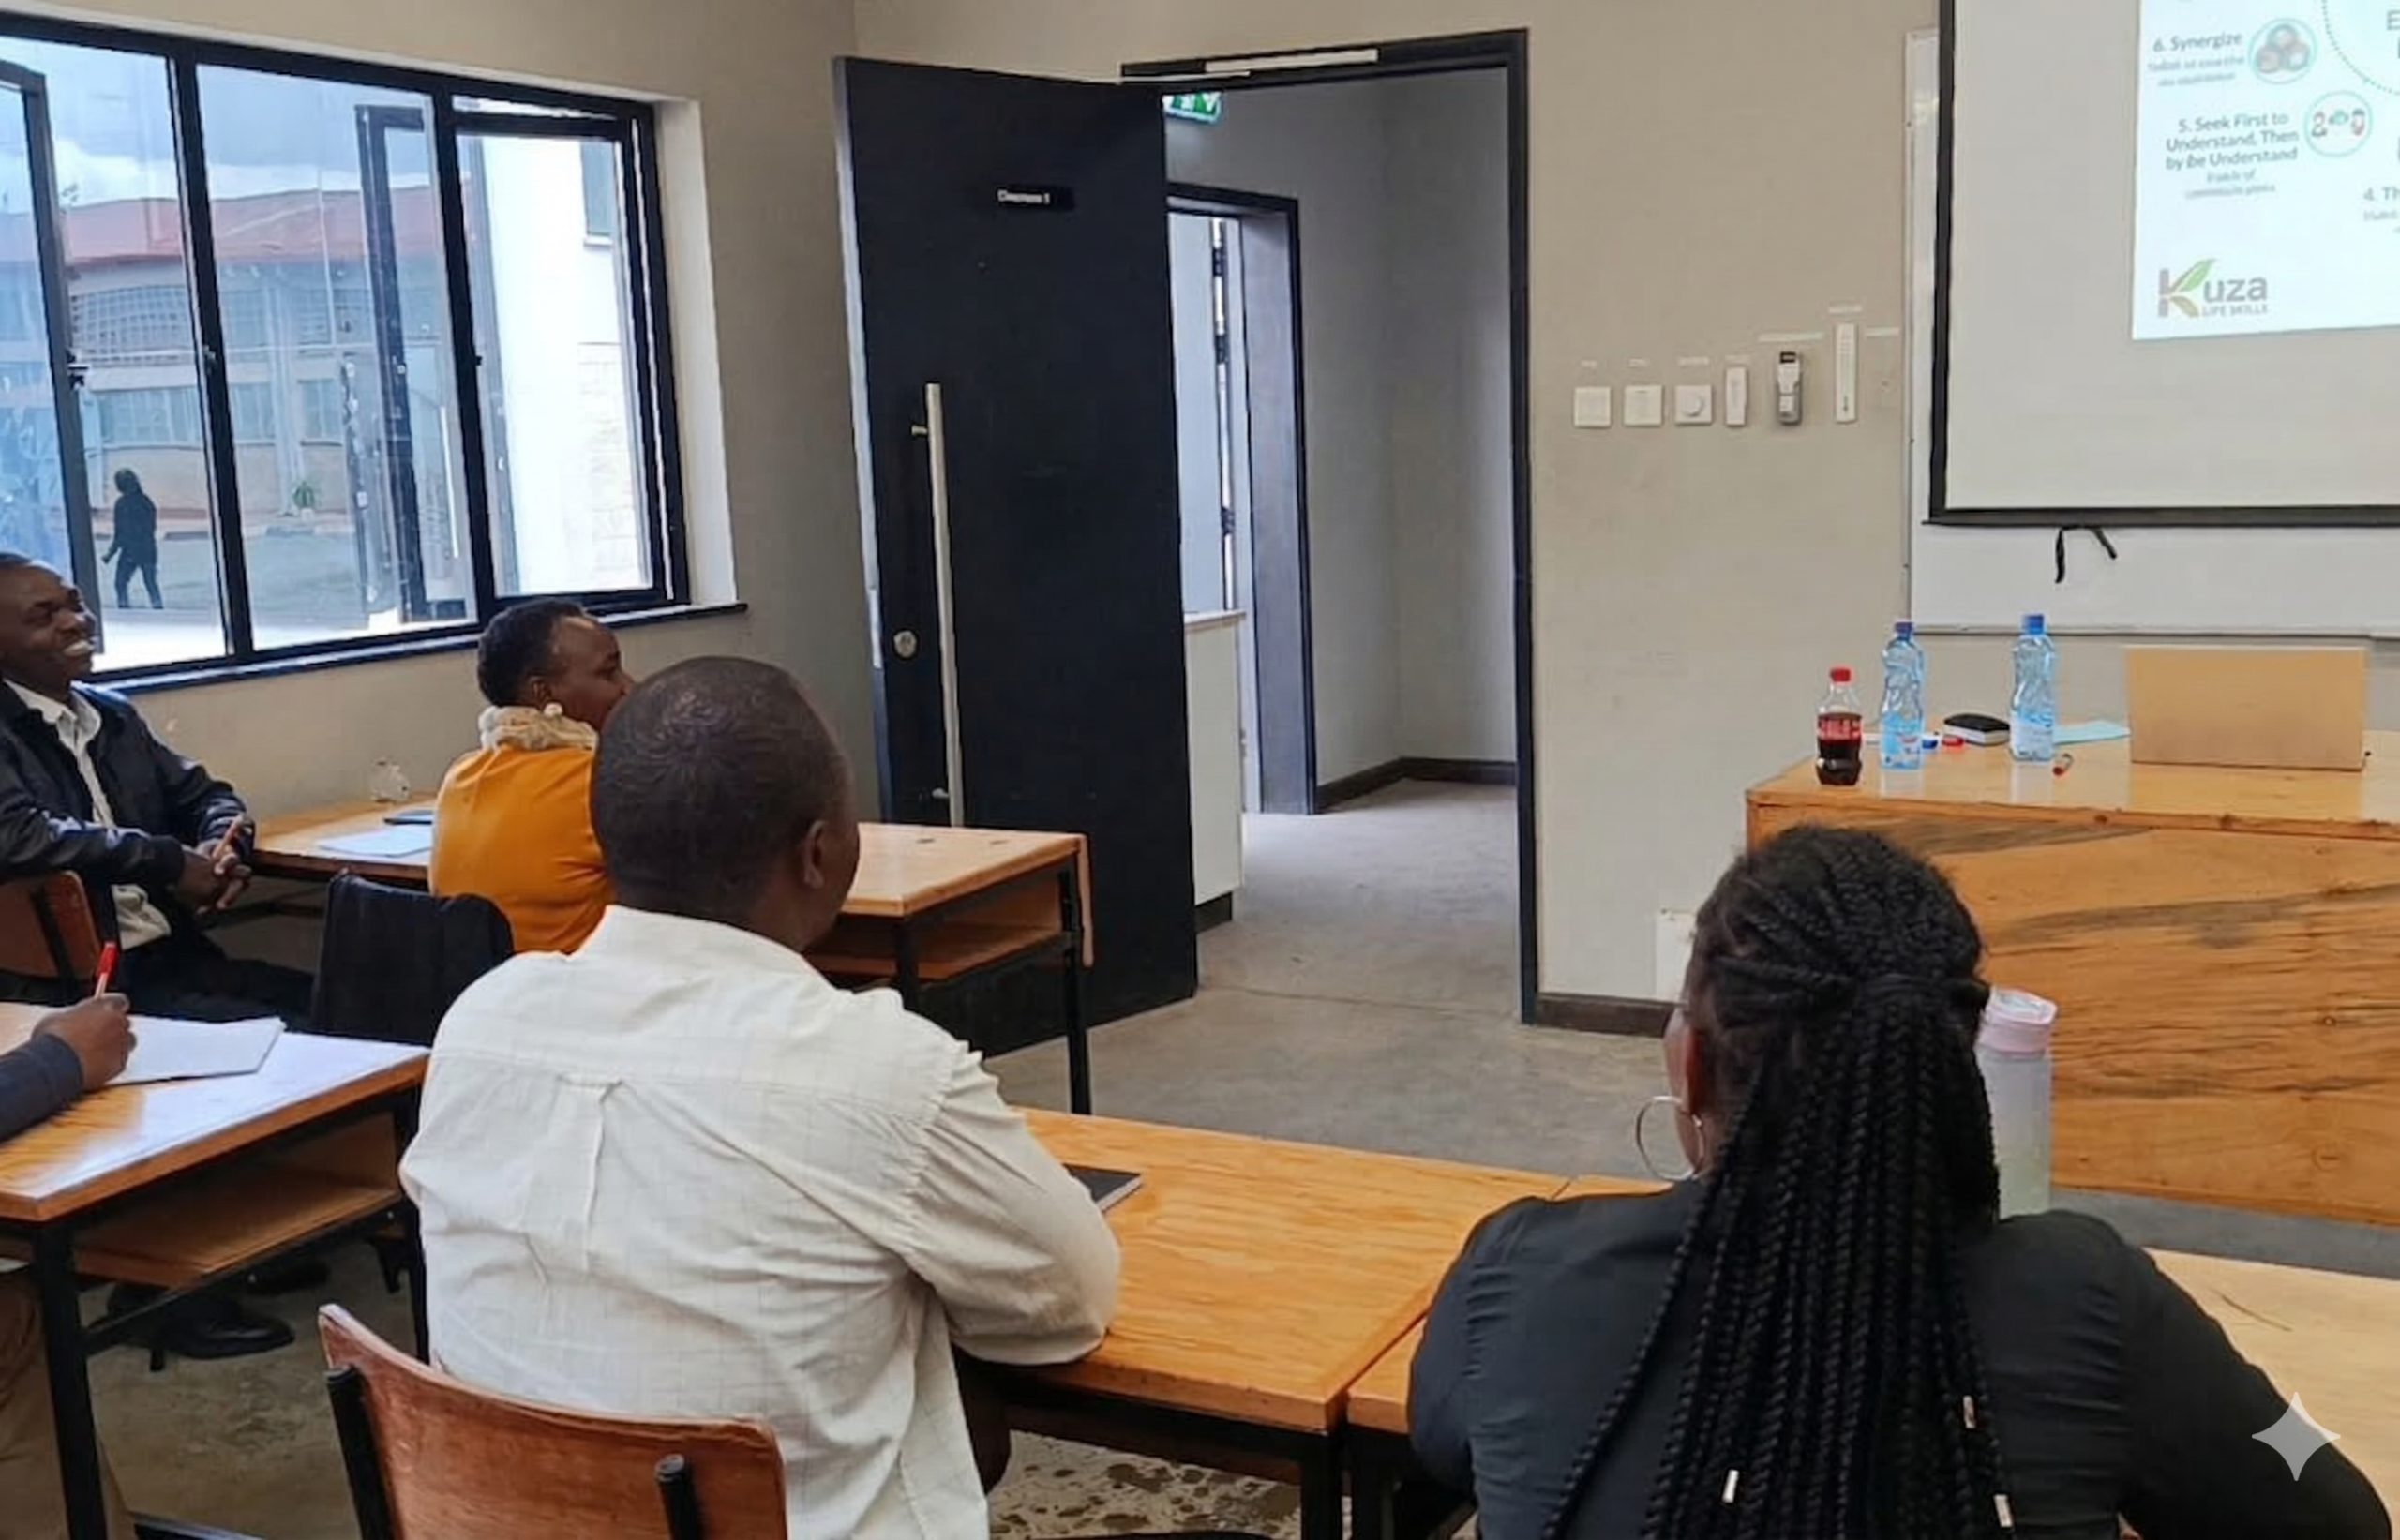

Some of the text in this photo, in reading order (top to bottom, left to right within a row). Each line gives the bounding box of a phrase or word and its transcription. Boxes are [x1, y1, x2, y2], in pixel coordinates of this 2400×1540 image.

[2170, 32, 2242, 52] Synergize
[2195, 117, 2230, 132] Seek
[2234, 113, 2268, 128] First
[2272, 113, 2289, 125] to
[2260, 130, 2299, 144] Then
[2166, 156, 2182, 171] by
[2209, 146, 2297, 167] Understand
